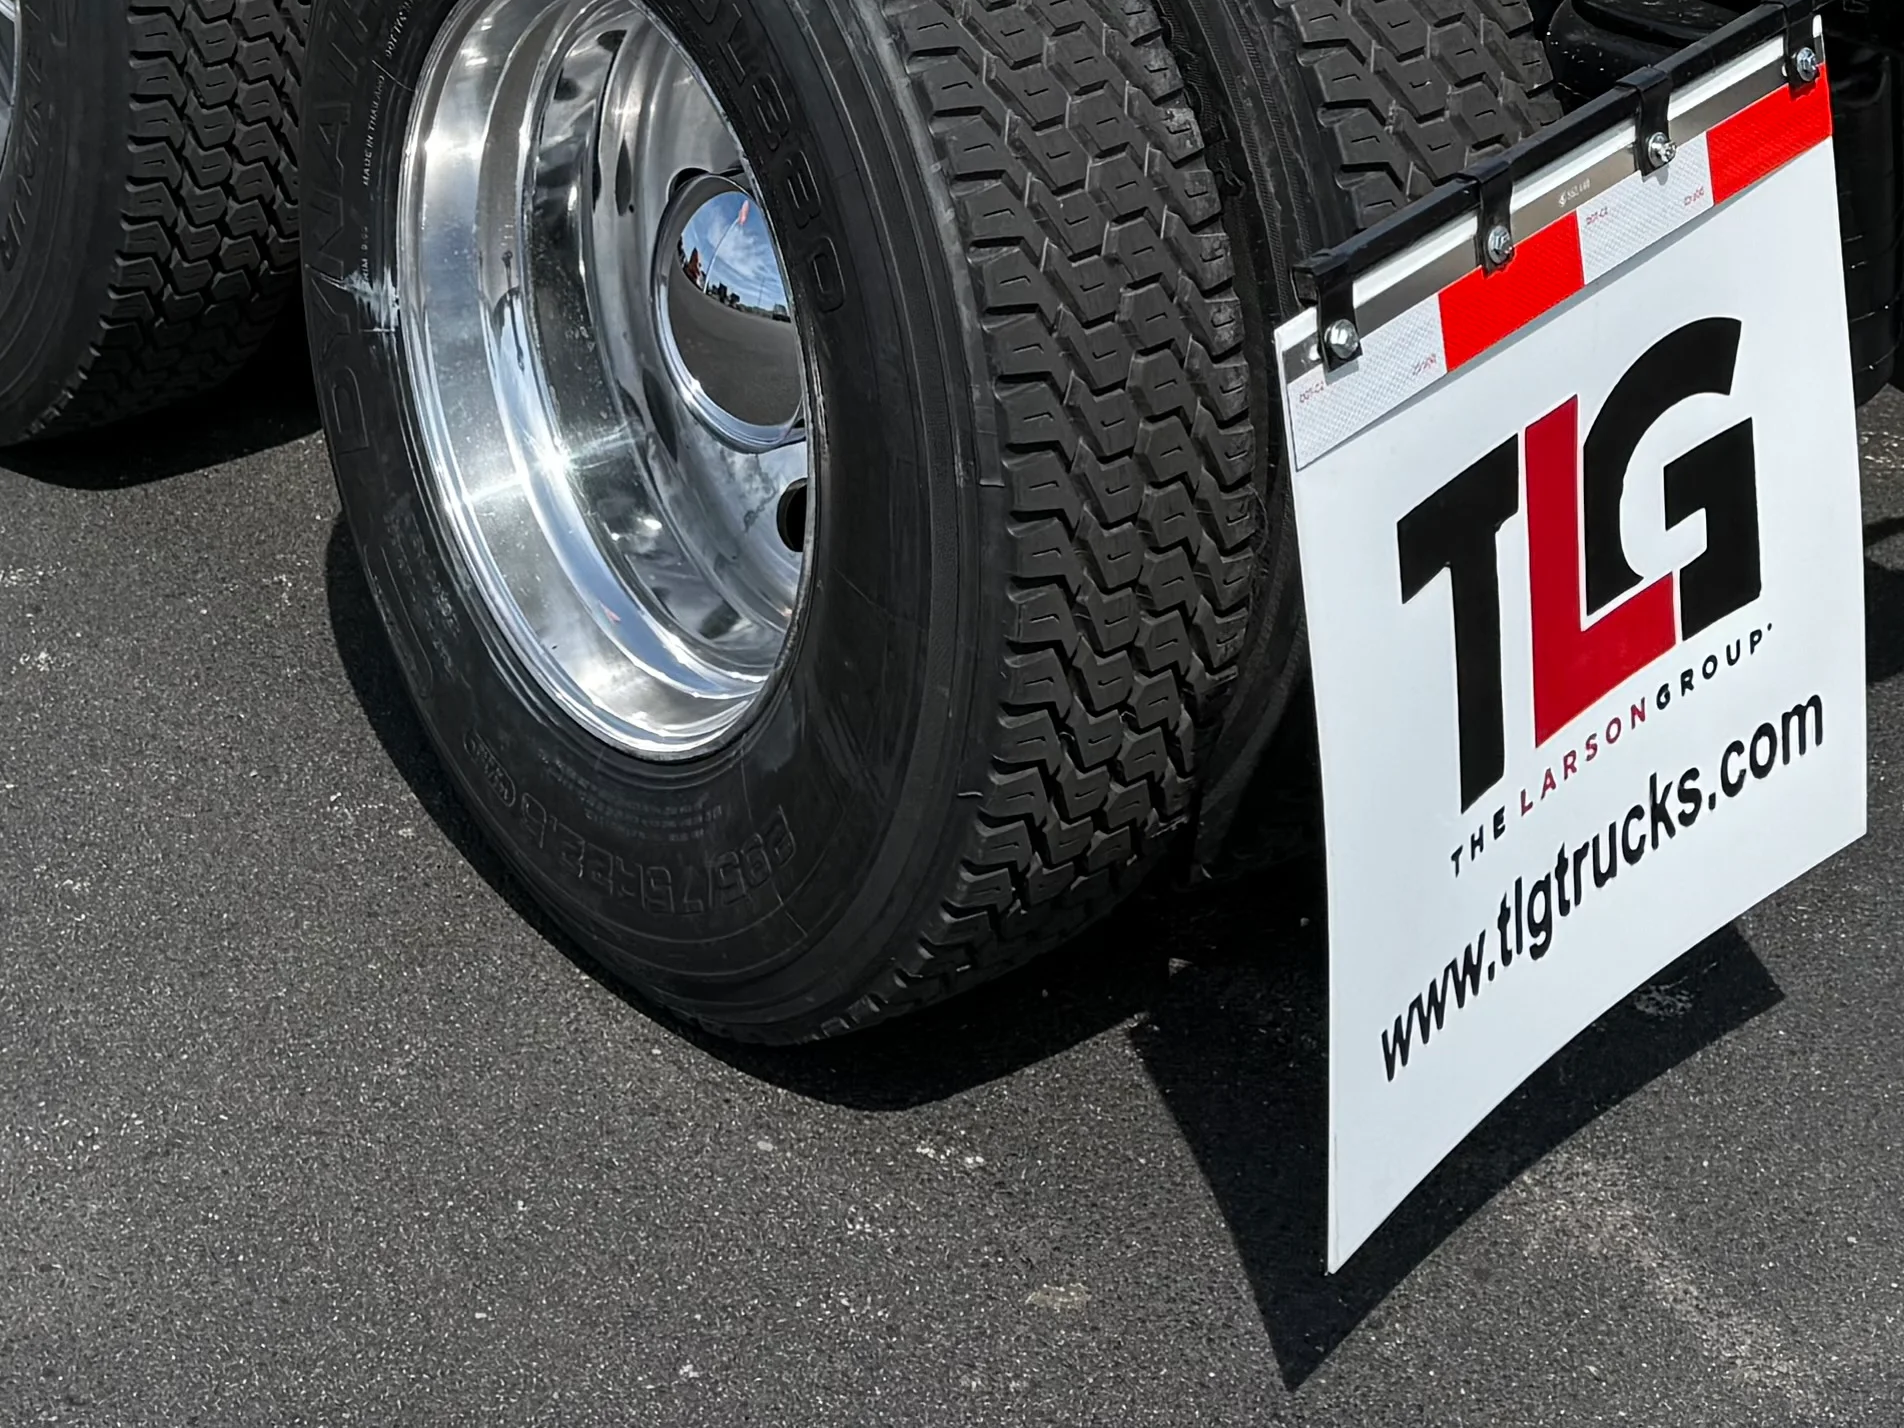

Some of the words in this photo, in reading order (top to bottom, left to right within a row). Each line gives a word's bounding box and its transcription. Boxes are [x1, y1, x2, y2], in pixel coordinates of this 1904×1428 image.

[1395, 316, 1764, 815] TLG
[1450, 806, 1507, 879] THE
[1520, 696, 1648, 817] LARSON
[1654, 628, 1764, 711] GROUP
[1380, 693, 1824, 1082] www.tlgtrucks.com
